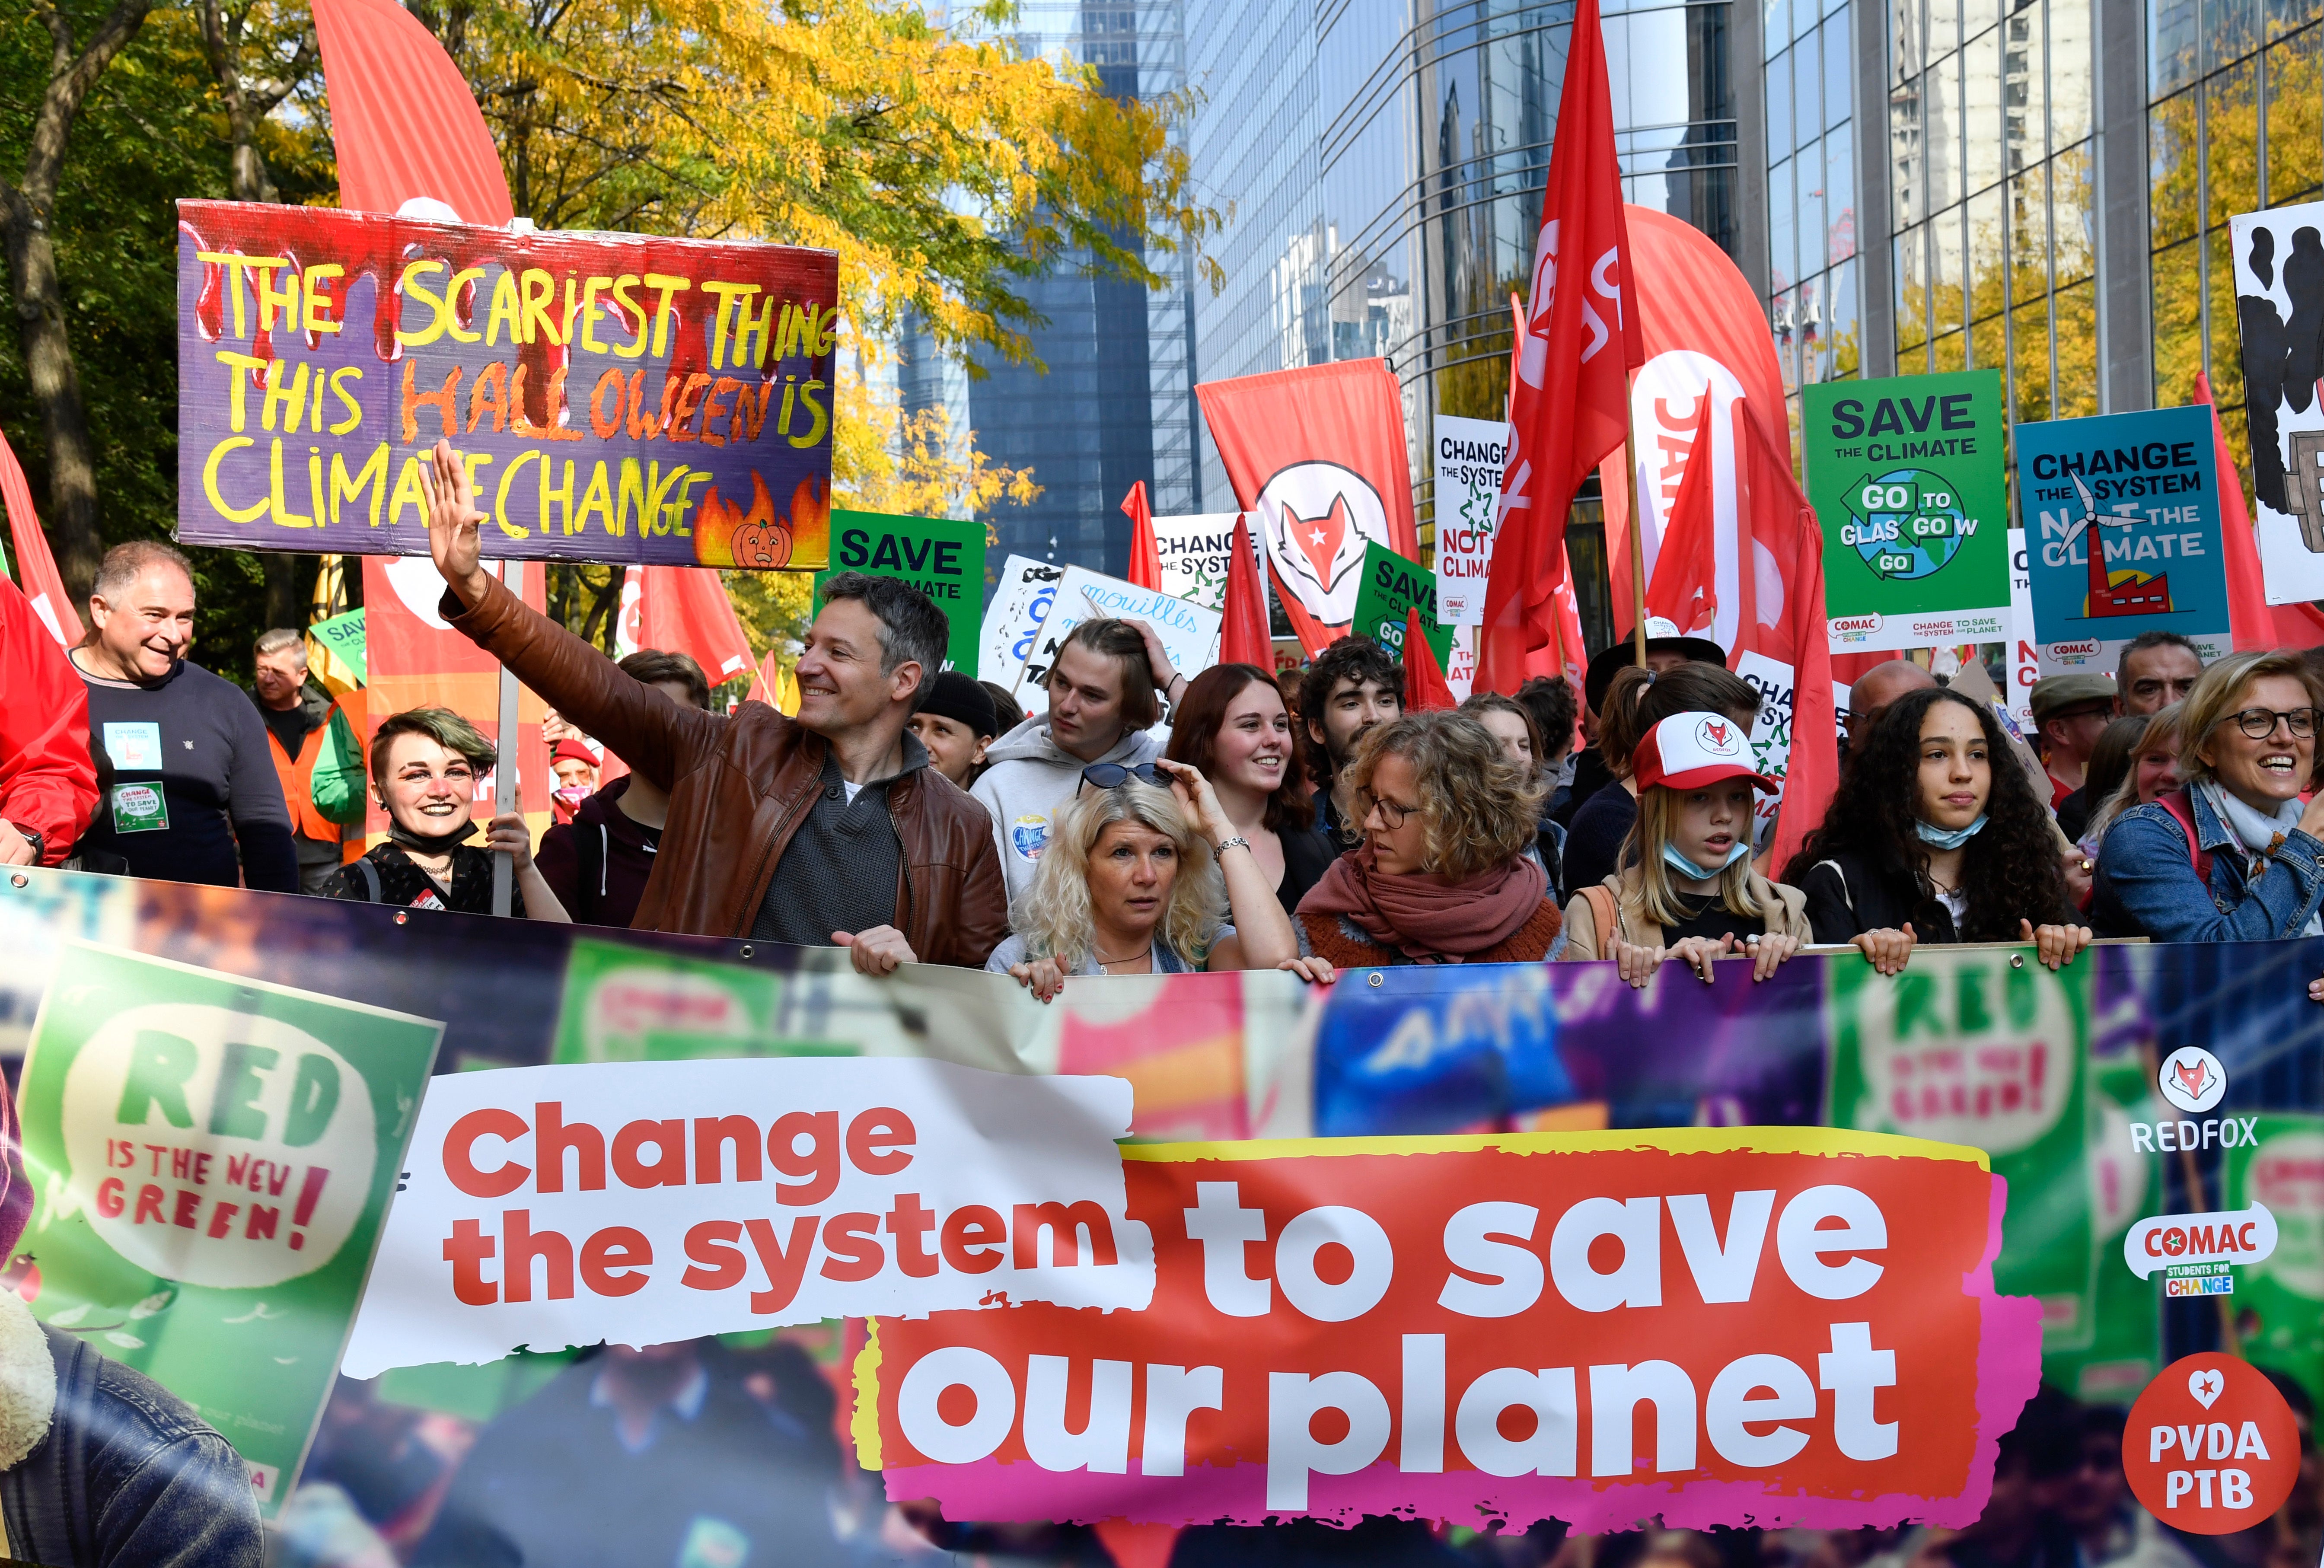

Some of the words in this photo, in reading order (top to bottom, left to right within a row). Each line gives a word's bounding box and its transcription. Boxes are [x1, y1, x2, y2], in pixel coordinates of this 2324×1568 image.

[197, 252, 344, 338] THE
[394, 261, 691, 357] SCARiEST
[216, 351, 362, 435] THiS
[402, 358, 773, 447] HALLOWEEN
[778, 375, 829, 448] iS
[1832, 393, 1976, 440] SAVE
[1835, 447, 1862, 459] THE
[1867, 438, 1977, 462] CLIMATE
[2032, 442, 2197, 480] CHANGE
[1441, 466, 1459, 478] THE
[1460, 465, 1502, 488] SYSTE
[2035, 487, 2073, 501] THE
[2094, 471, 2201, 500] SYSTEM
[495, 449, 713, 539] CHANGE
[1862, 485, 1908, 509] GO
[1923, 492, 1951, 509] TO
[2145, 505, 2201, 526] THE
[840, 529, 963, 575] SAVE
[1443, 529, 1487, 555] NOT
[1160, 561, 1178, 571] HE
[1181, 553, 1260, 575] SYST
[1879, 555, 1907, 570] GO
[903, 580, 961, 599] MATE
[1376, 561, 1437, 614] SAVE
[1082, 584, 1197, 633] mouillés
[1374, 589, 1387, 602] THE
[1389, 597, 1441, 634] CLIATE
[327, 618, 366, 641] SAV
[1380, 622, 1403, 646] GO
[1834, 619, 1875, 631] COMAC
[1913, 621, 1953, 631] CHANGE
[1924, 629, 1954, 637] SYSTEM
[1967, 625, 2003, 634] PLANET
[2054, 644, 2094, 654] COMAC
[121, 788, 150, 798] CHANGE
[1014, 827, 1042, 846] CHANGE
[117, 1029, 341, 1147] RED
[2130, 1117, 2258, 1153] REDFOX
[106, 1138, 135, 1168] IS
[144, 1144, 213, 1185] THE
[442, 1101, 917, 1206] Change
[443, 1209, 653, 1306] the
[680, 1193, 1119, 1315] system
[1186, 1180, 1394, 1322] to
[1437, 1183, 1888, 1314] save
[2144, 1221, 2256, 1258] COMAC
[2168, 1264, 2212, 1277] STUDENTS
[2213, 1262, 2230, 1274] FOR
[2168, 1276, 2232, 1296] CHANGE
[897, 1345, 1224, 1478] our
[1267, 1321, 1899, 1512] planet
[2149, 1421, 2271, 1463] PVDA
[2166, 1469, 2254, 1509] PTB
